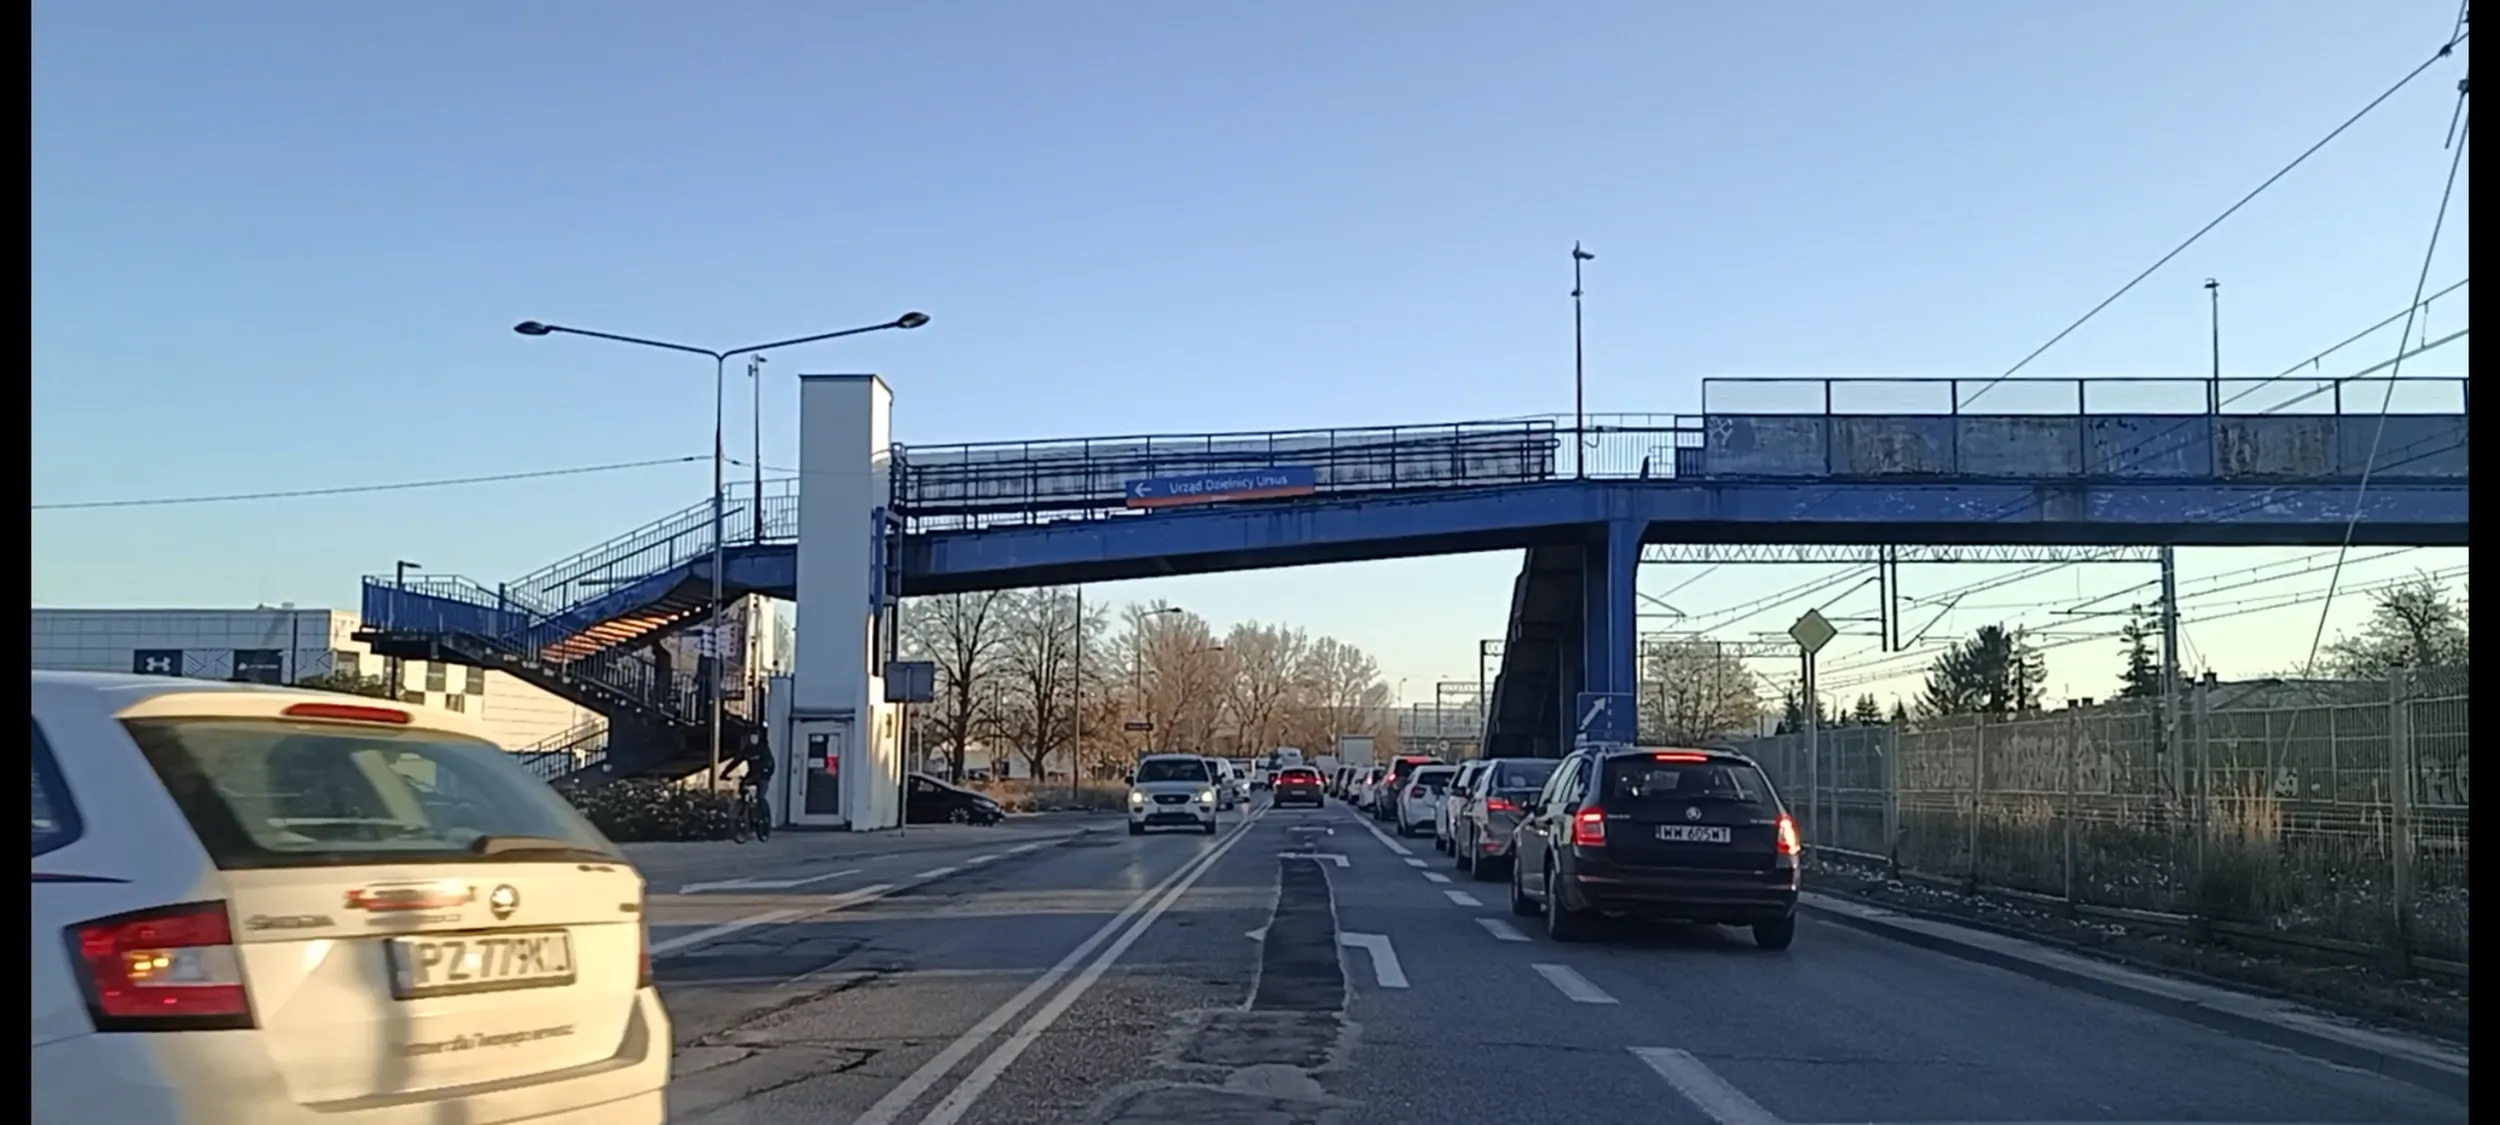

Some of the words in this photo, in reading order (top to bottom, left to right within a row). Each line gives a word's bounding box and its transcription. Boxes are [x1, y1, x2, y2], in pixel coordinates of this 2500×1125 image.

[1169, 479, 1203, 495] Urząd
[1205, 476, 1254, 491] Dzielnicy
[1256, 475, 1288, 486] Ursus
[413, 941, 471, 983] PZ
